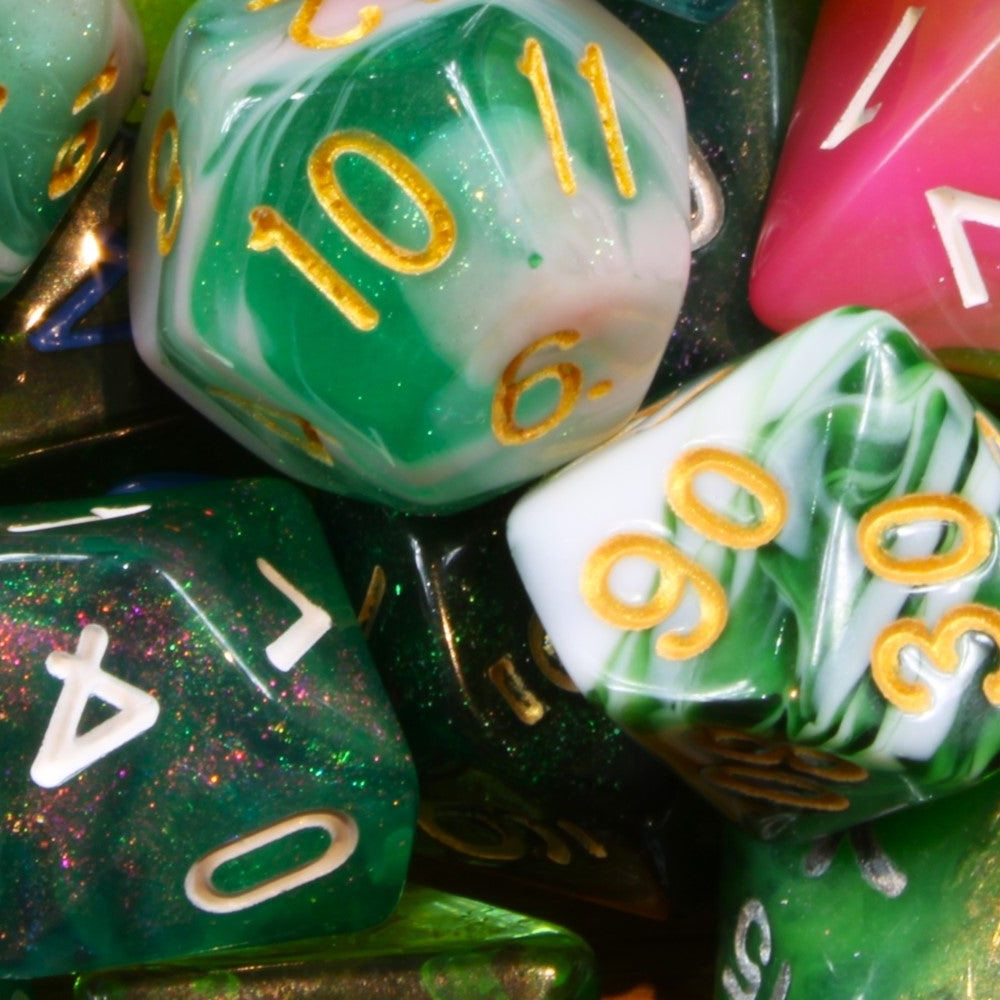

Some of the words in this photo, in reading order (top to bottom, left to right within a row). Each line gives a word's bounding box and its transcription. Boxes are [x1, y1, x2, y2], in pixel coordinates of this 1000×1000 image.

[517, 36, 637, 200] 11
[246, 129, 458, 334] 10
[580, 446, 788, 662] 90
[856, 492, 1000, 716] 30
[30, 623, 161, 789] 4
[184, 808, 361, 915] 0
